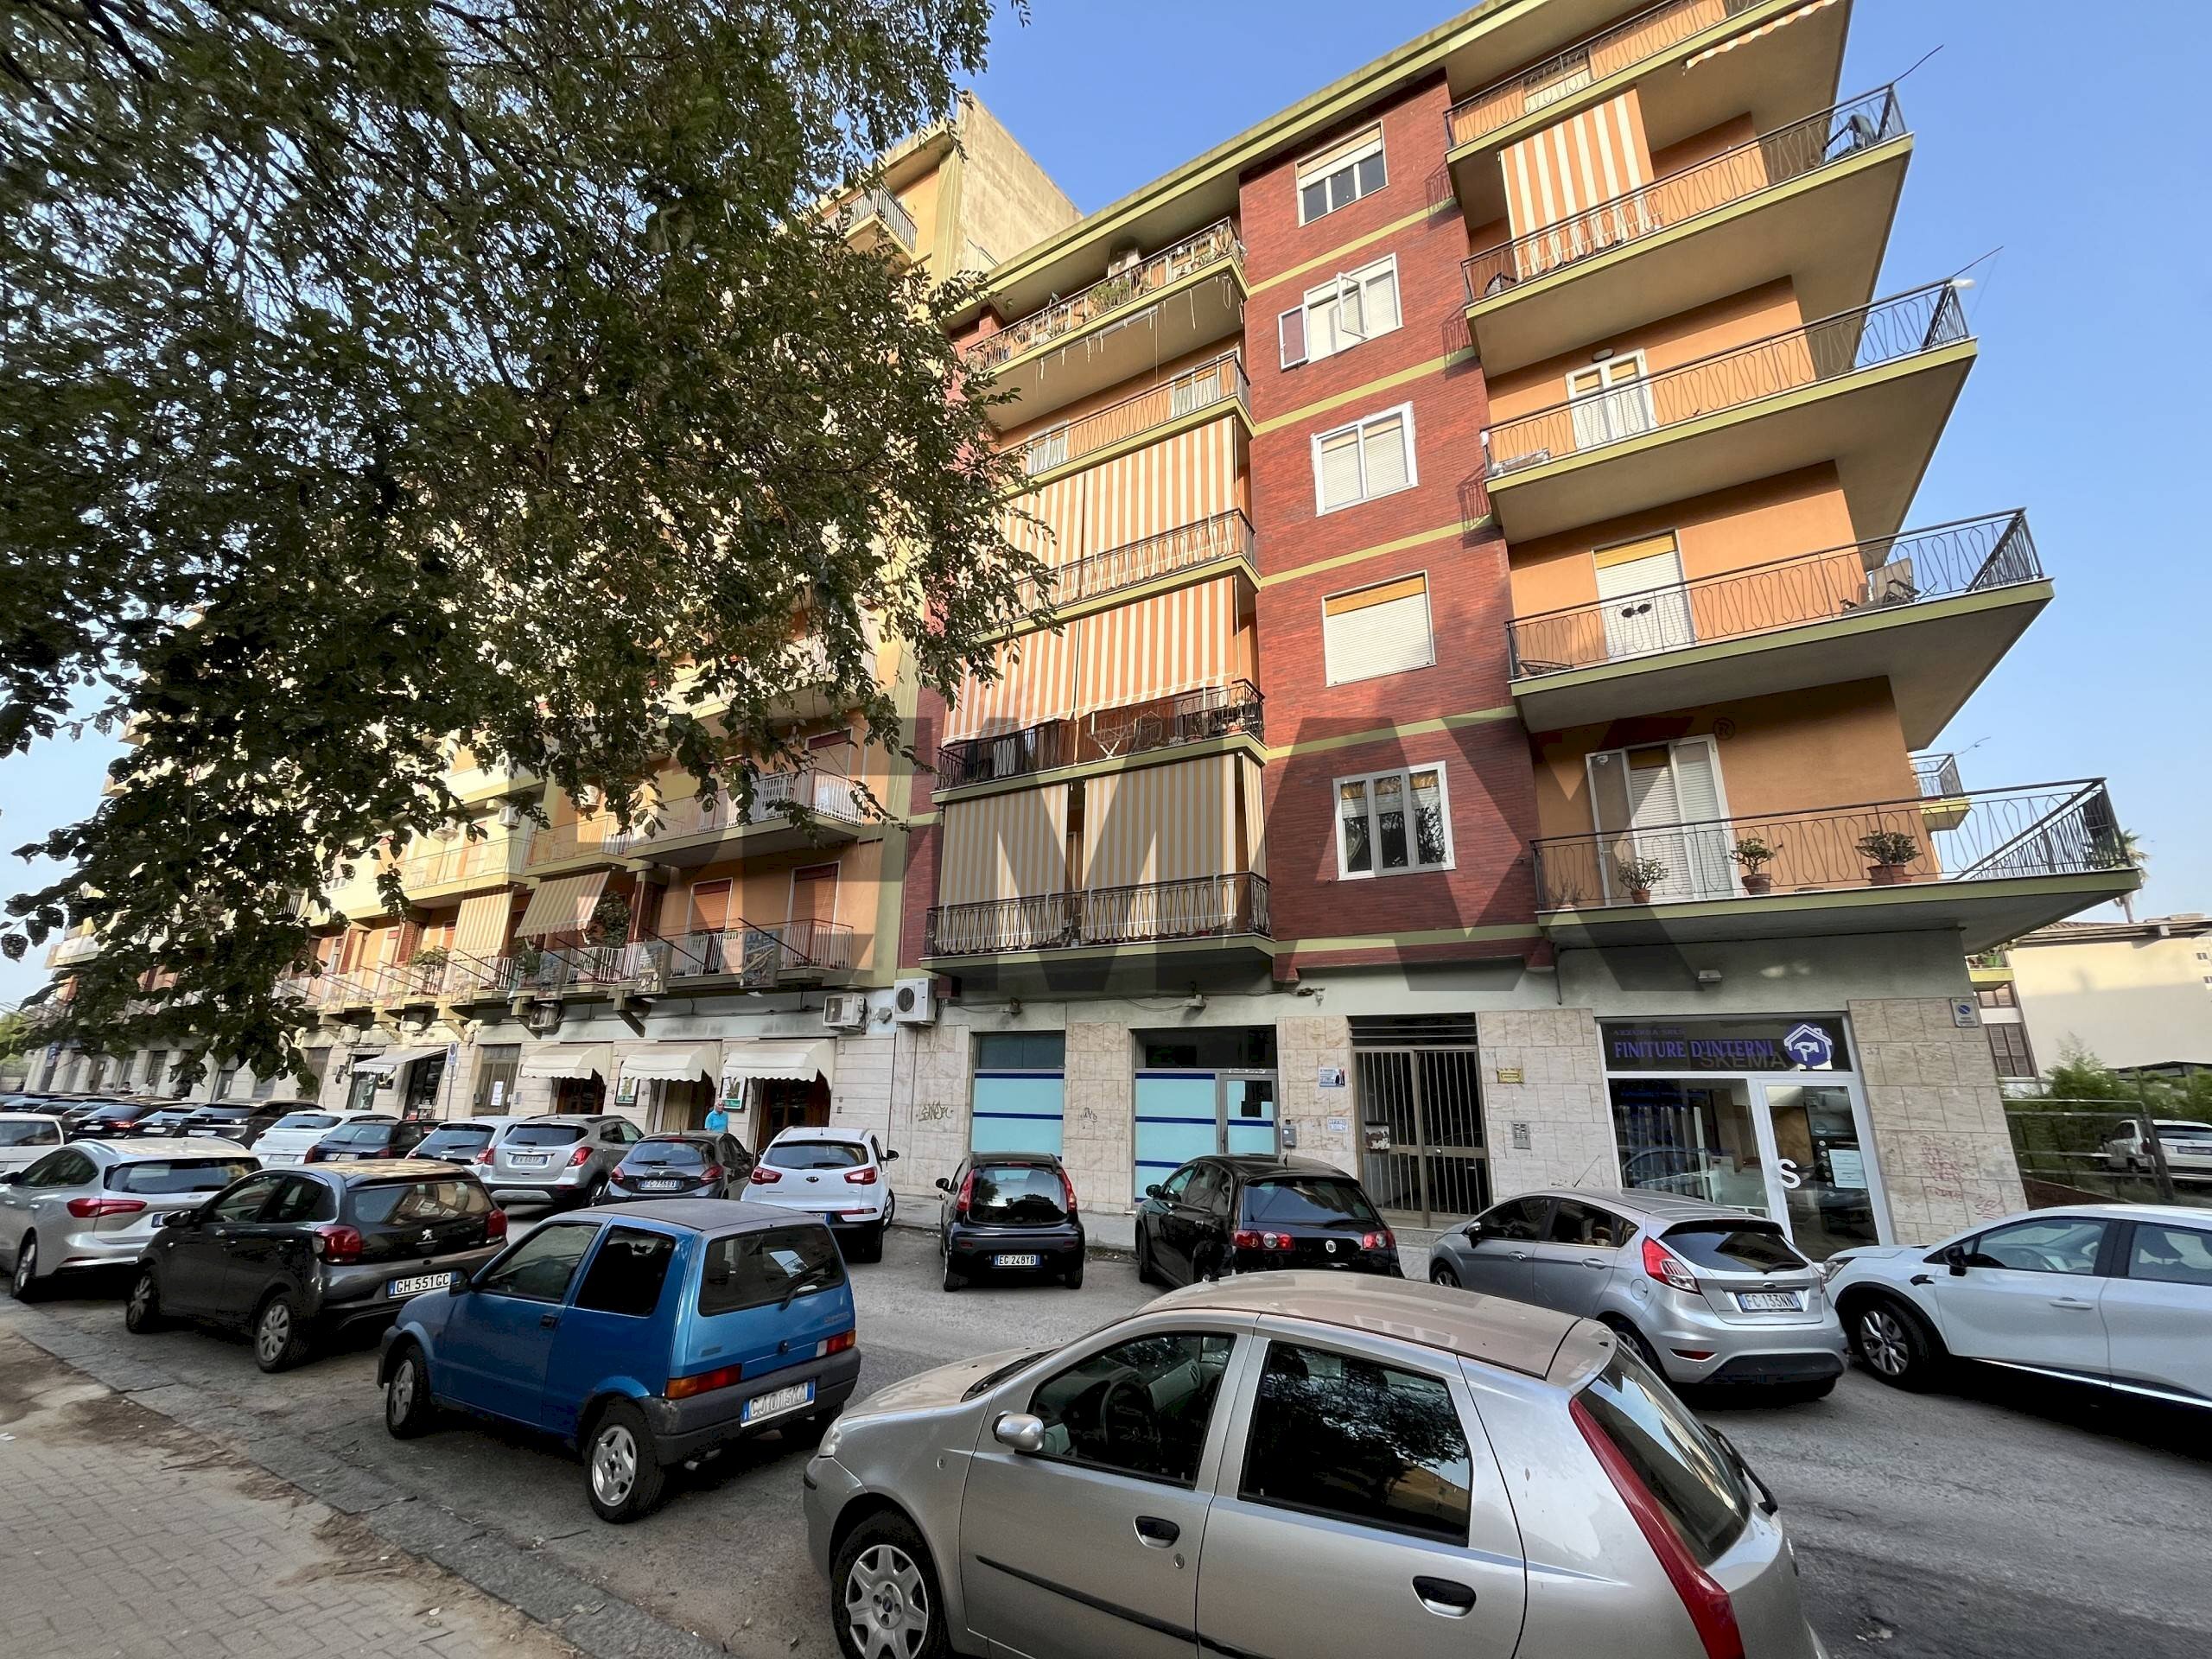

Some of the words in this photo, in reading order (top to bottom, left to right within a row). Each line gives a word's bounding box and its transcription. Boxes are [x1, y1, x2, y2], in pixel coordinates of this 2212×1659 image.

[1614, 1040, 1686, 1058] FINITURE
[1691, 1039, 1775, 1058] D'INTERNI
[1700, 1052, 1787, 1069] SKEMA
[1777, 1158, 1802, 1189] S
[397, 1280, 411, 1293] GH
[415, 1274, 449, 1290] 551GC
